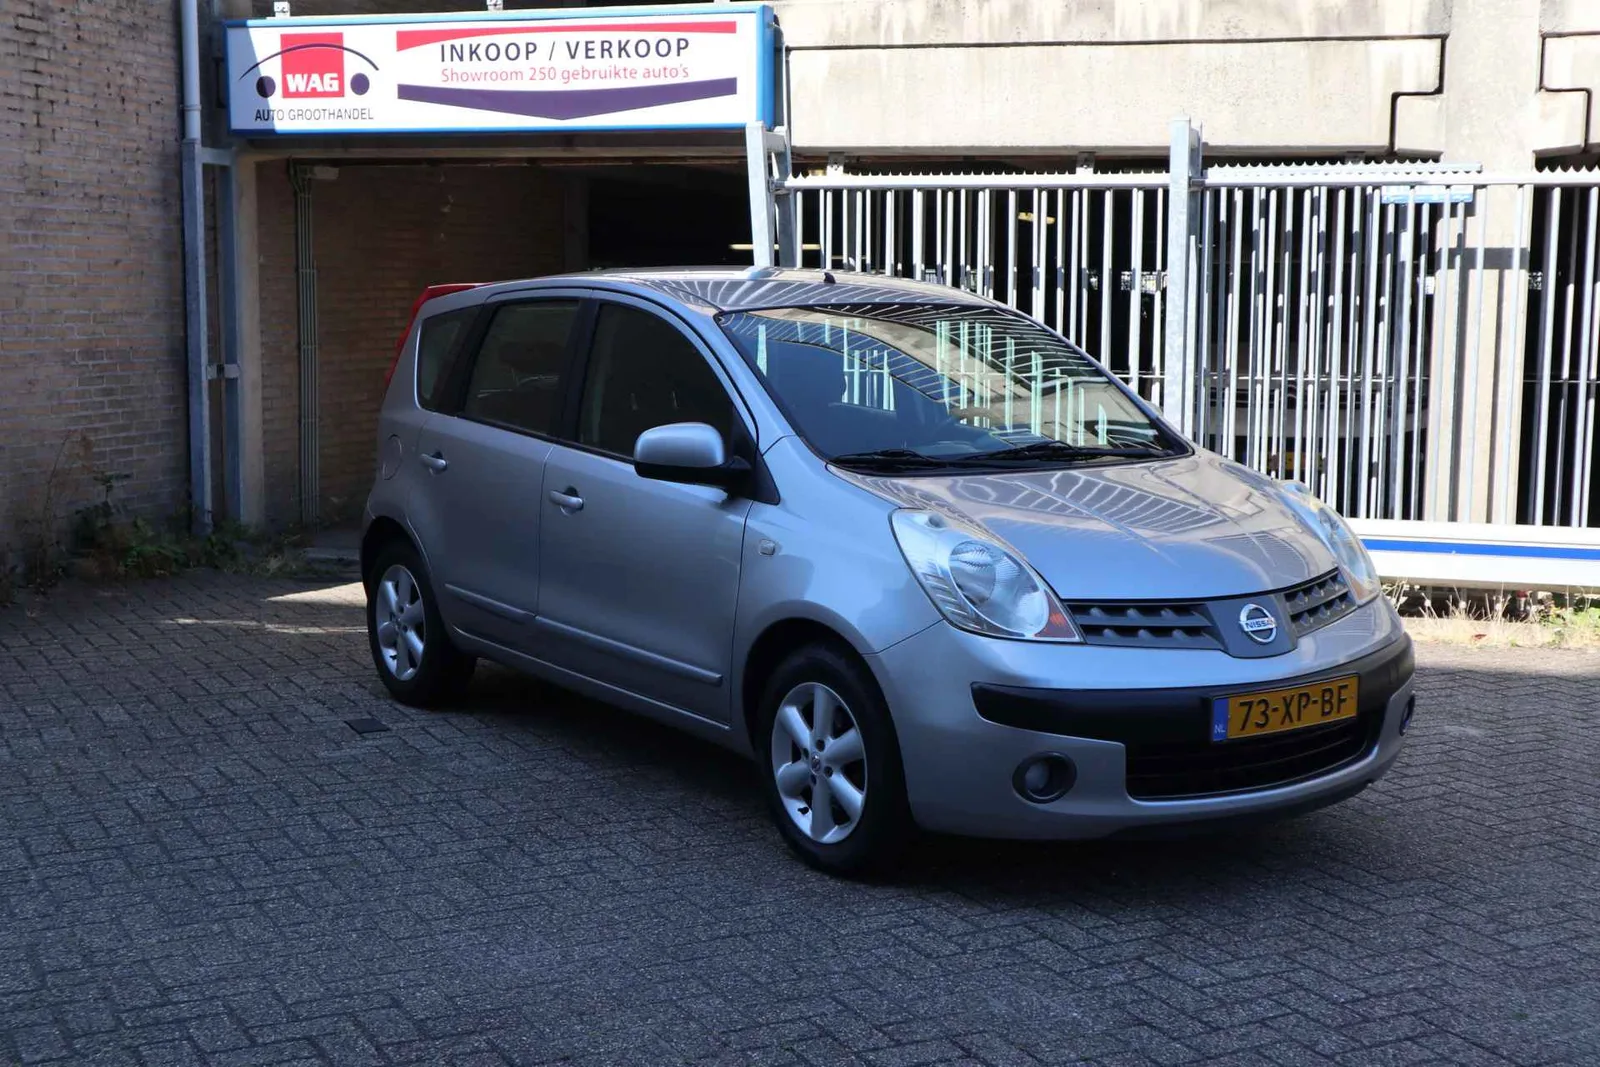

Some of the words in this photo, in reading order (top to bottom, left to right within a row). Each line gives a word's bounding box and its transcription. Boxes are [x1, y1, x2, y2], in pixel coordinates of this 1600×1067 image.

[440, 41, 538, 63] INKOOP
[548, 40, 556, 61] /
[565, 37, 690, 60] VERKOOP
[286, 72, 340, 93] WAG
[441, 68, 524, 83] Showroom
[528, 66, 557, 81] 250
[561, 64, 638, 84] gebruikte
[642, 63, 690, 79] auto's
[254, 108, 285, 122] AUTO
[288, 107, 374, 121] GROOTHANDEL
[1238, 684, 1349, 731] 73-XP-BF
[1214, 724, 1226, 734] NL
